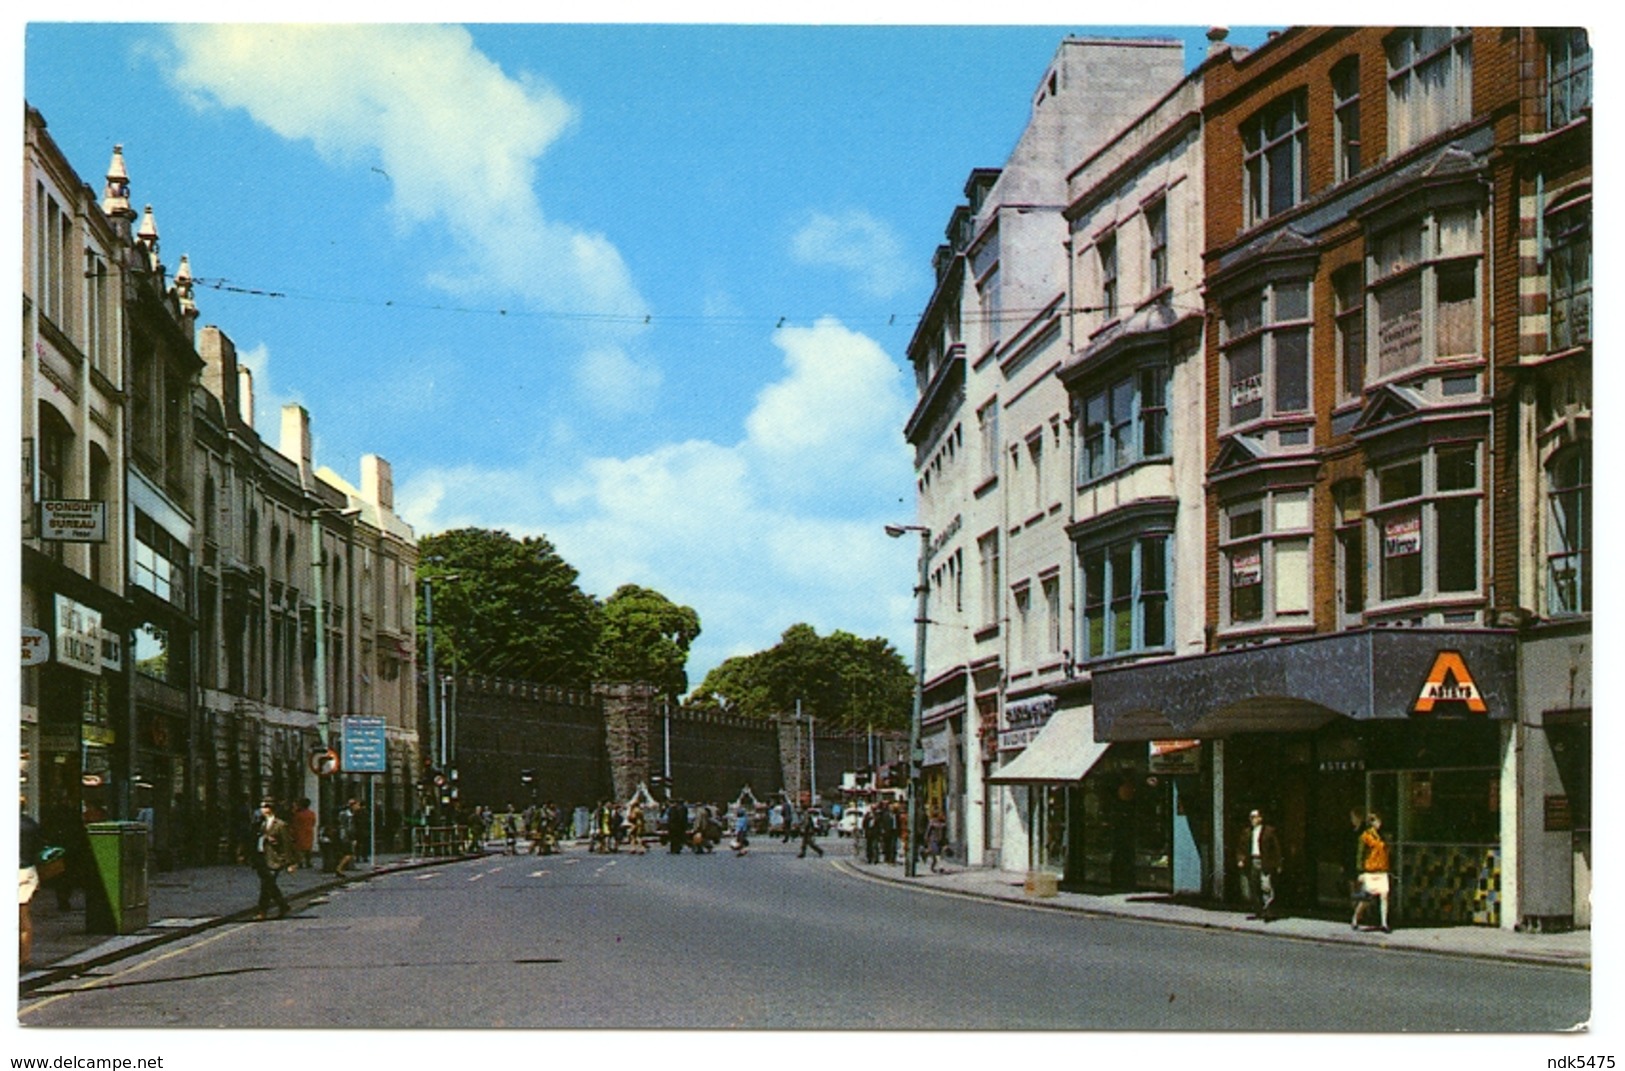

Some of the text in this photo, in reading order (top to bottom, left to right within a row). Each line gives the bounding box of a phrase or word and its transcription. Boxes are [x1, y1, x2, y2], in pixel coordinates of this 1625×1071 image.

[45, 502, 99, 512] CONDUIT
[49, 518, 96, 528] BUREAU
[1429, 685, 1472, 698] ASTEYS
